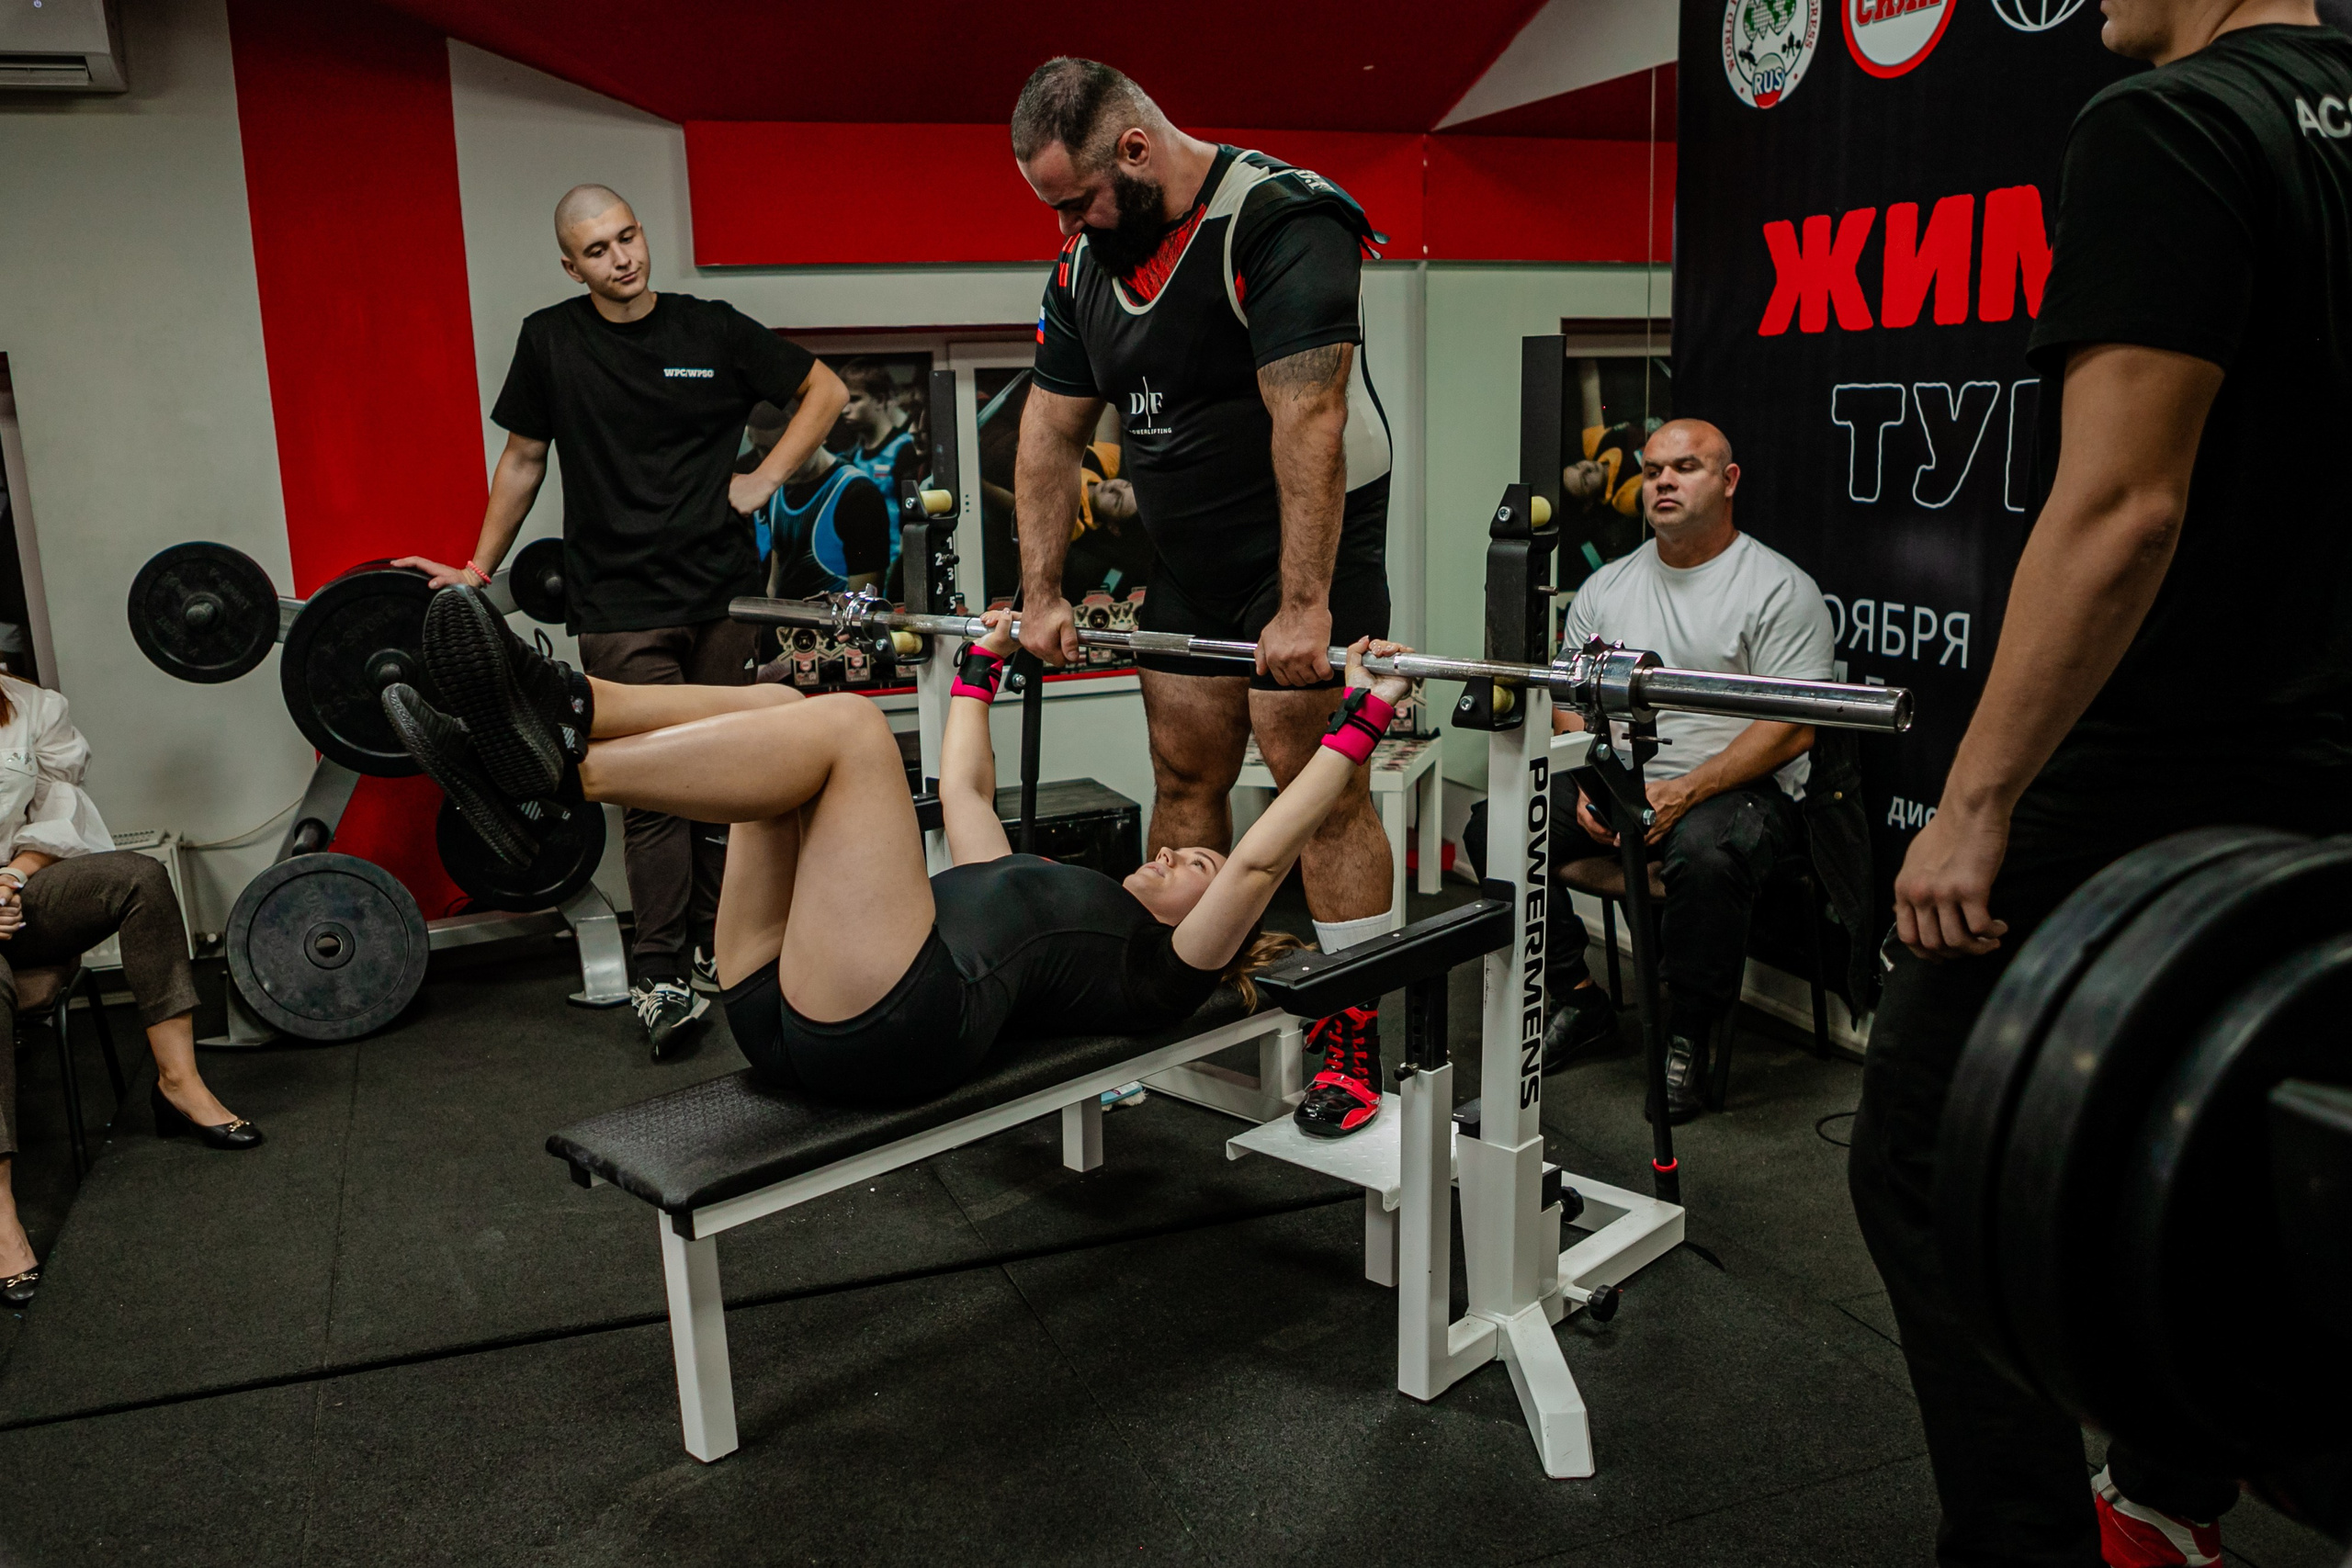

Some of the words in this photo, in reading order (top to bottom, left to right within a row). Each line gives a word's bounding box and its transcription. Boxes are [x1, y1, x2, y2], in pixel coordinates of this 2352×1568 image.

[1804, 0, 1819, 49] GRESS
[1754, 66, 1782, 96] RUS
[1129, 427, 1172, 435] OWERLIFTING
[946, 536, 953, 549] 1
[935, 552, 943, 566] 2
[947, 568, 954, 581] 3
[949, 596, 956, 609] 5
[1822, 594, 1971, 670] ОЯБРЯ
[1521, 756, 1550, 1111] POWERMENS
